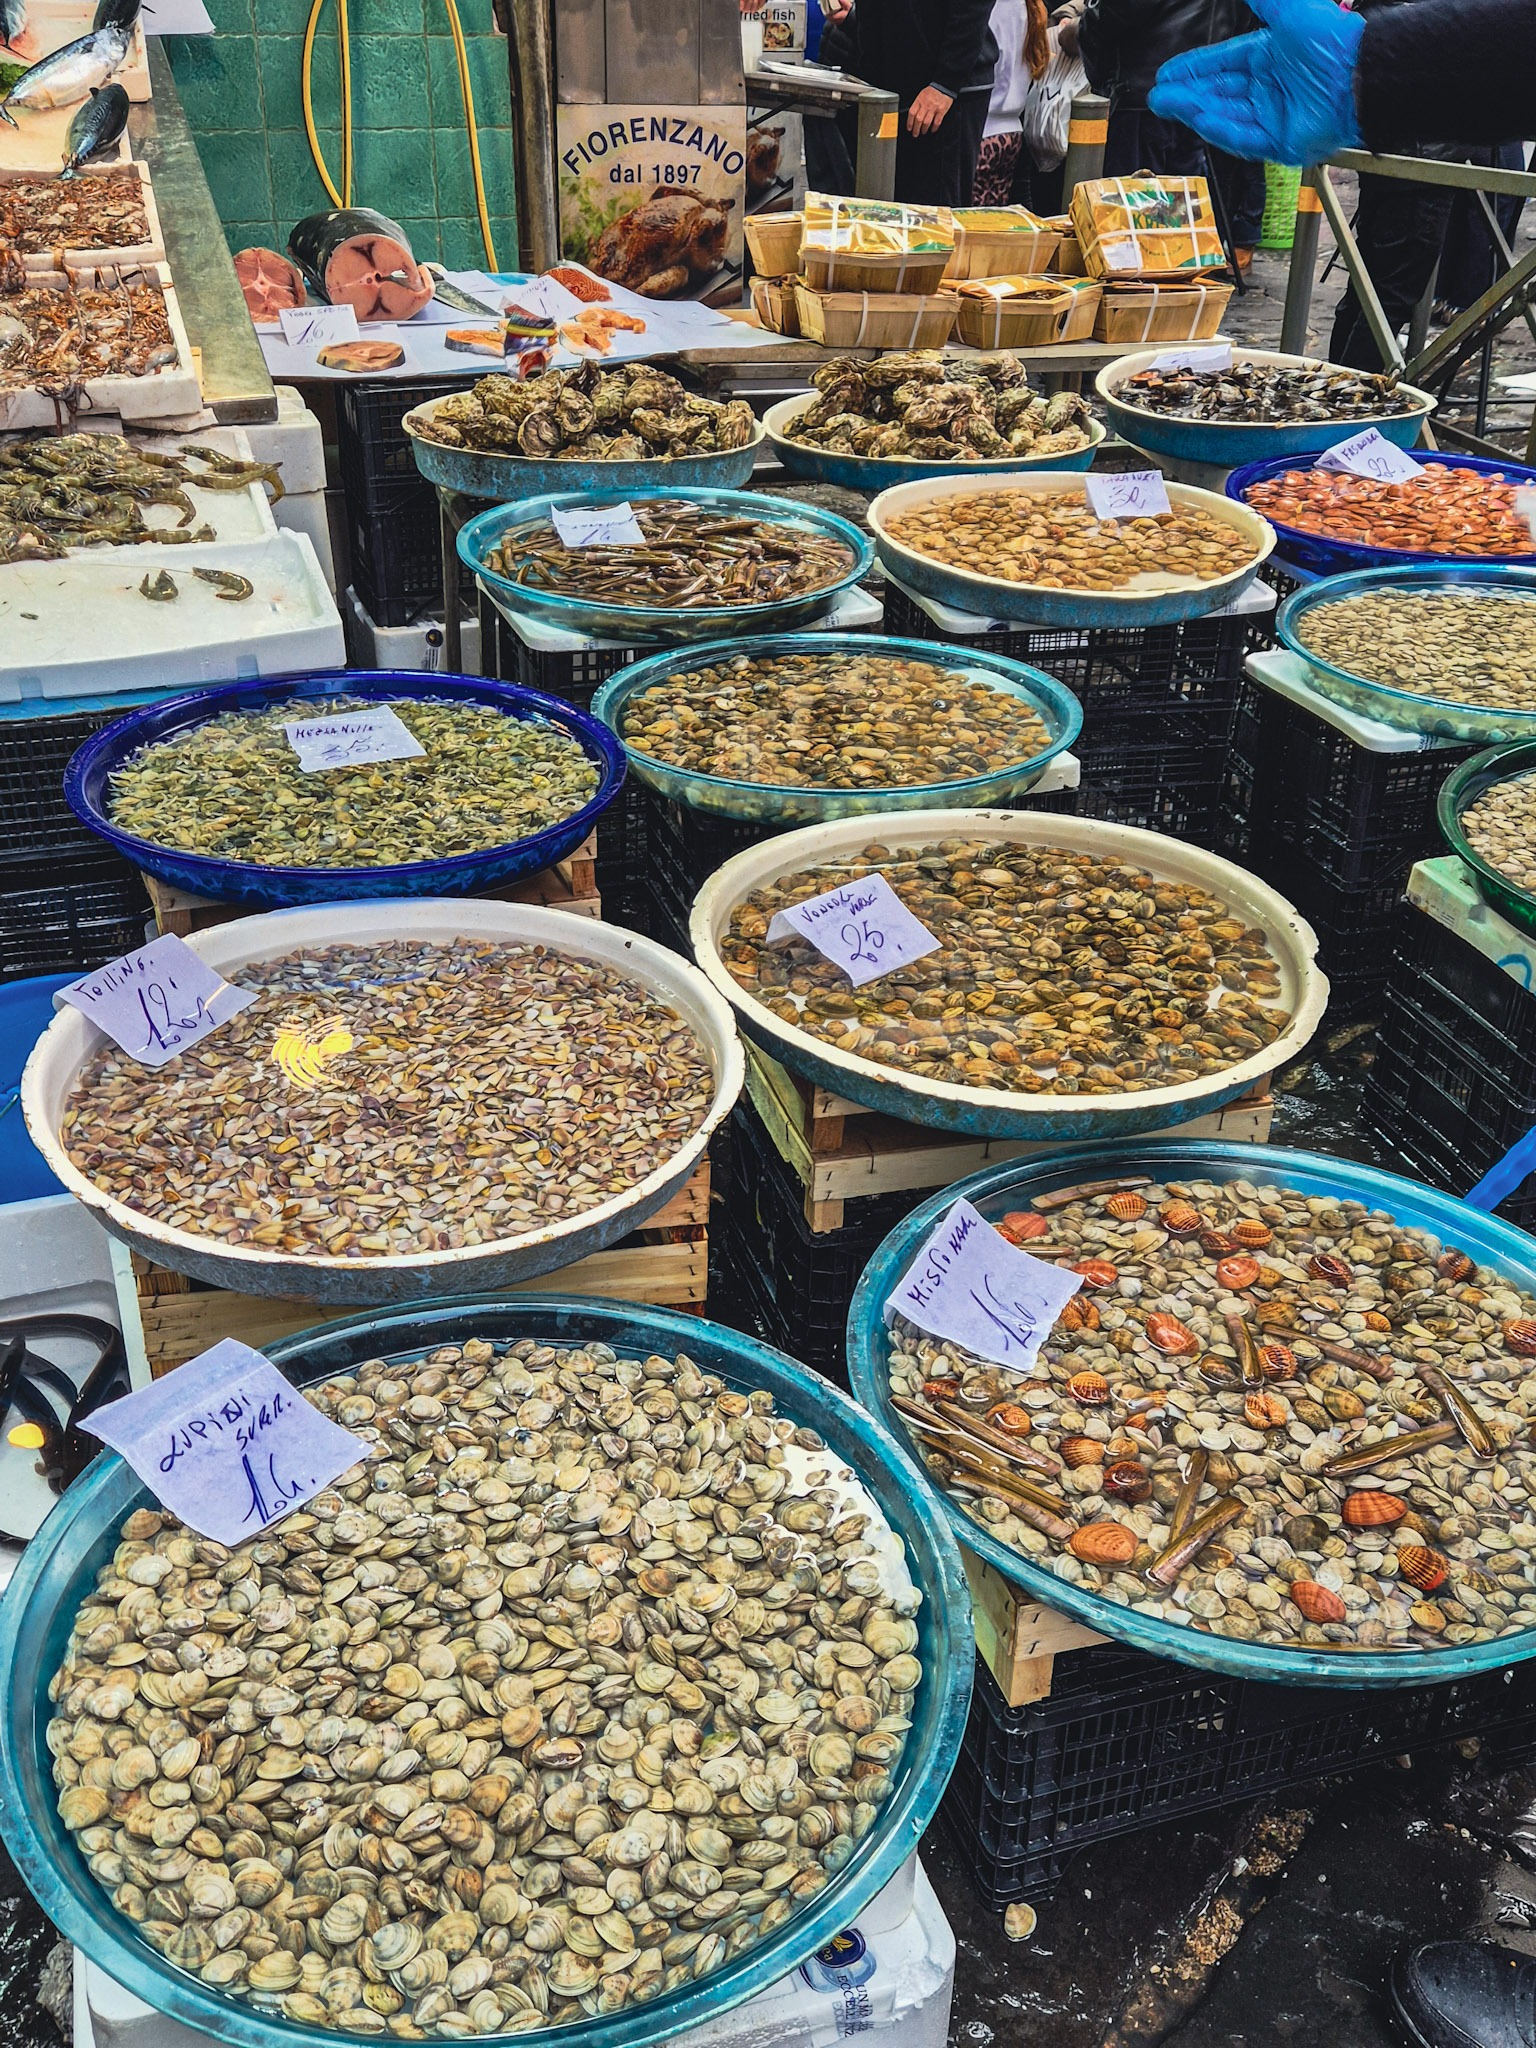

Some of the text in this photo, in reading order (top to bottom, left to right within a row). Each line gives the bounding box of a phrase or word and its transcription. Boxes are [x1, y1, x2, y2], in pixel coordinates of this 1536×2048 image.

[773, 9, 796, 20] fish
[562, 117, 744, 176] FIORENZANO
[609, 164, 702, 184] dal 1897
